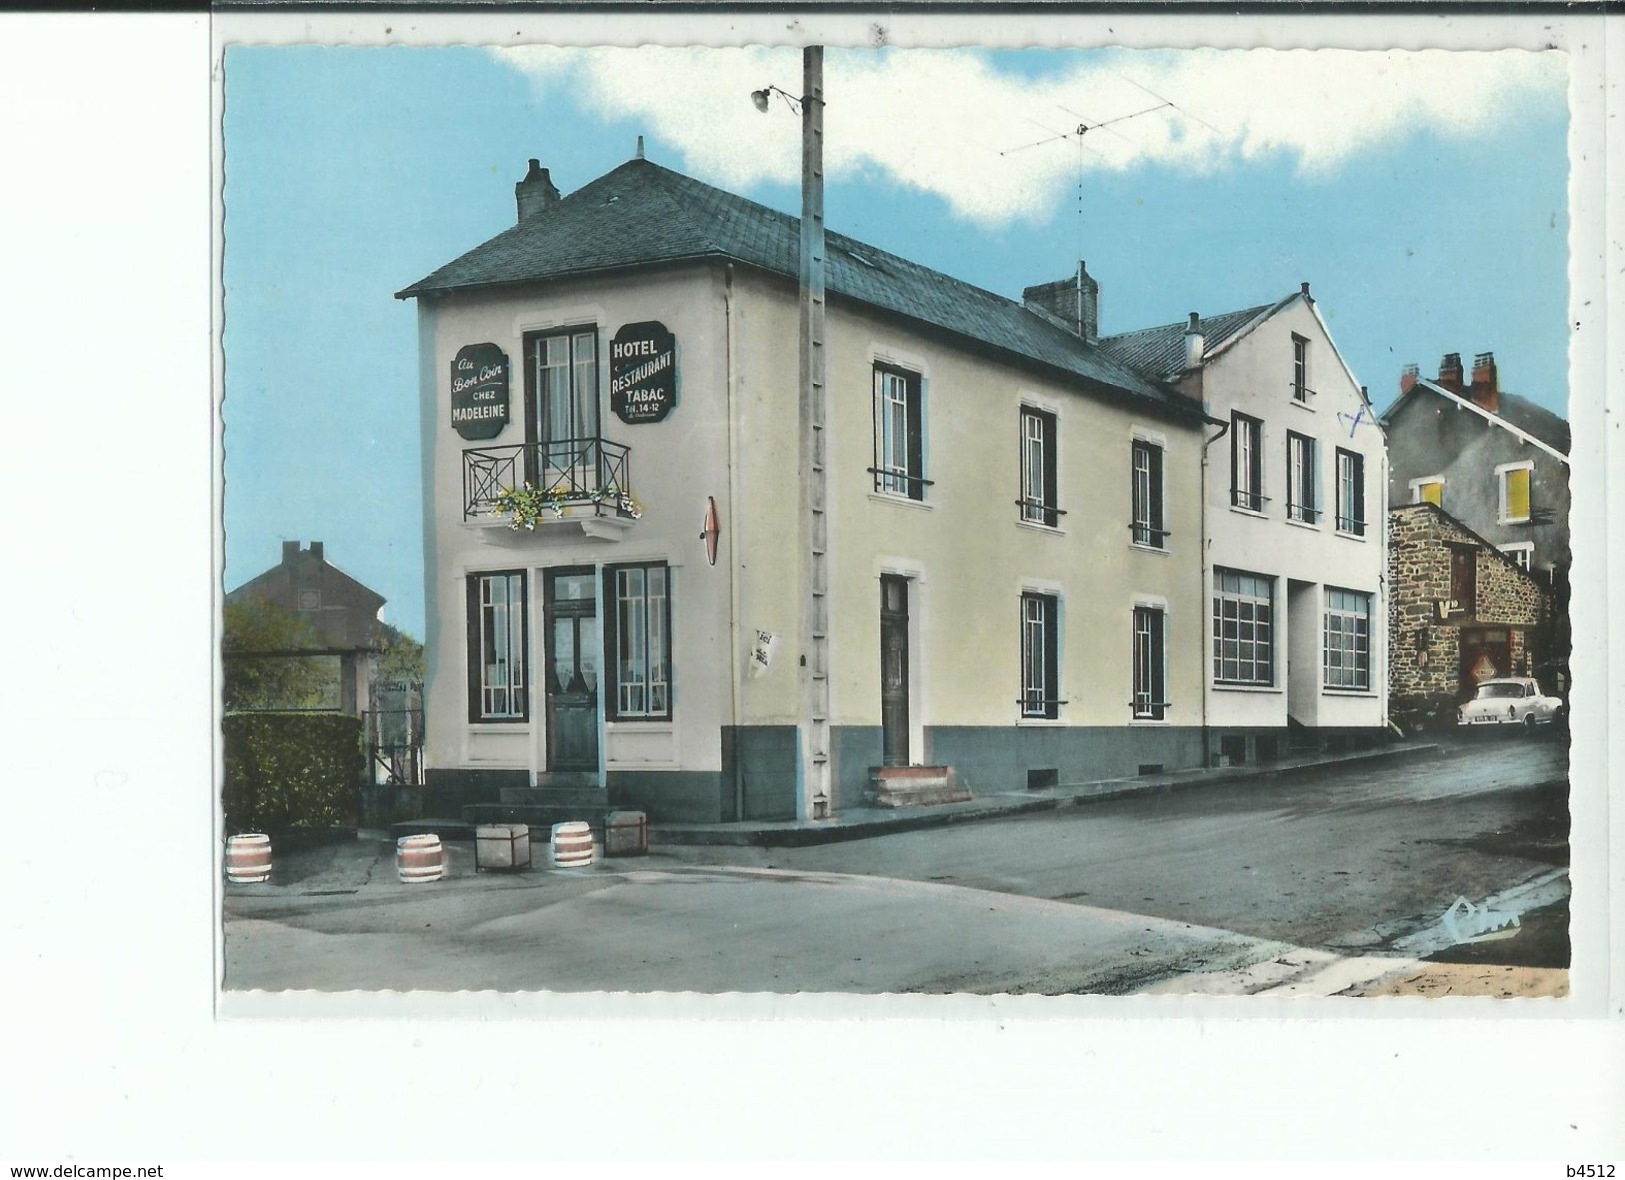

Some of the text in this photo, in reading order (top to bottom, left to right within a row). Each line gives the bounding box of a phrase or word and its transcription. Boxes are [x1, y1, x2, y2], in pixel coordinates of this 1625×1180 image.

[614, 340, 658, 358] HOTEL
[452, 363, 503, 393] Bon Coin
[612, 350, 672, 394] RESTAURANT
[472, 390, 495, 401] CHEZ
[625, 388, 665, 403] TABAC
[452, 404, 505, 421] MADELEINE
